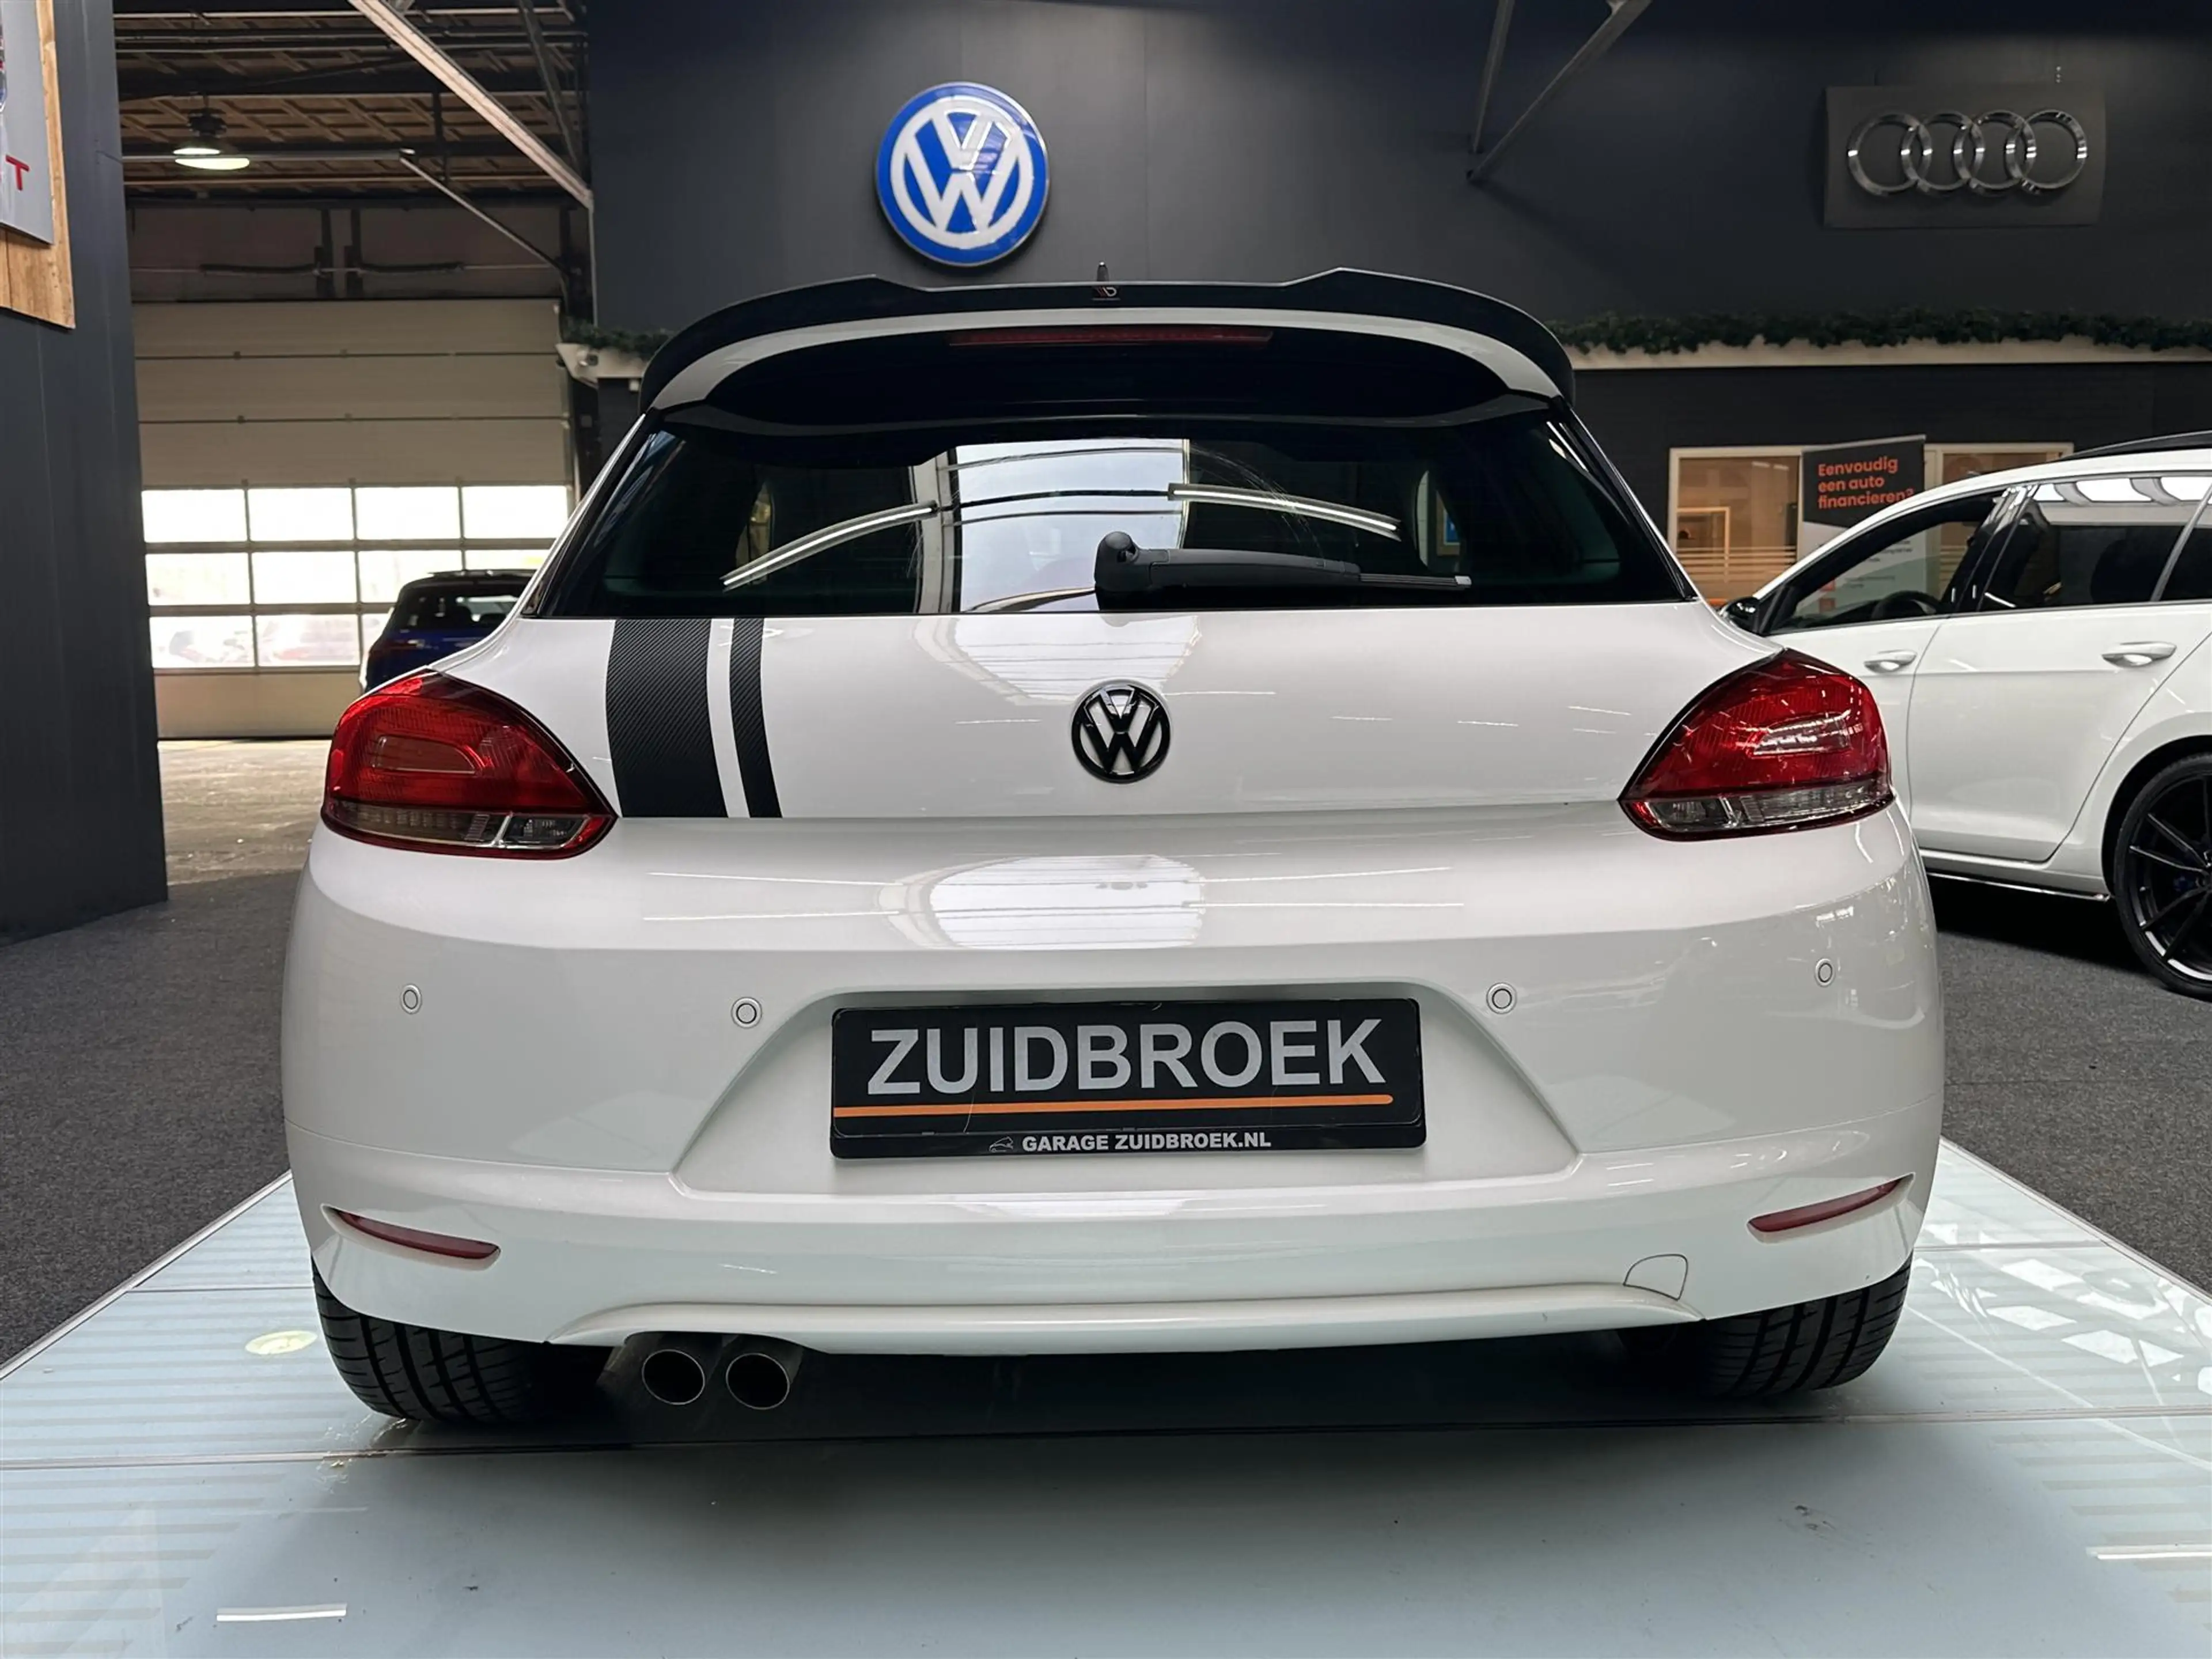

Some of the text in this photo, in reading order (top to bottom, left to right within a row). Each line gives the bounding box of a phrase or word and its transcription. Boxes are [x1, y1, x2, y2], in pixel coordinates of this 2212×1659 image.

[891, 96, 1034, 249] VW
[1818, 456, 1899, 476] Eenvoudig
[1818, 476, 1885, 493] een auto
[1074, 682, 1168, 782] VW
[867, 1018, 1387, 1096] ZUIDBROEK
[1022, 1132, 1271, 1152] GARAGE ZUIDBROEK.NL
